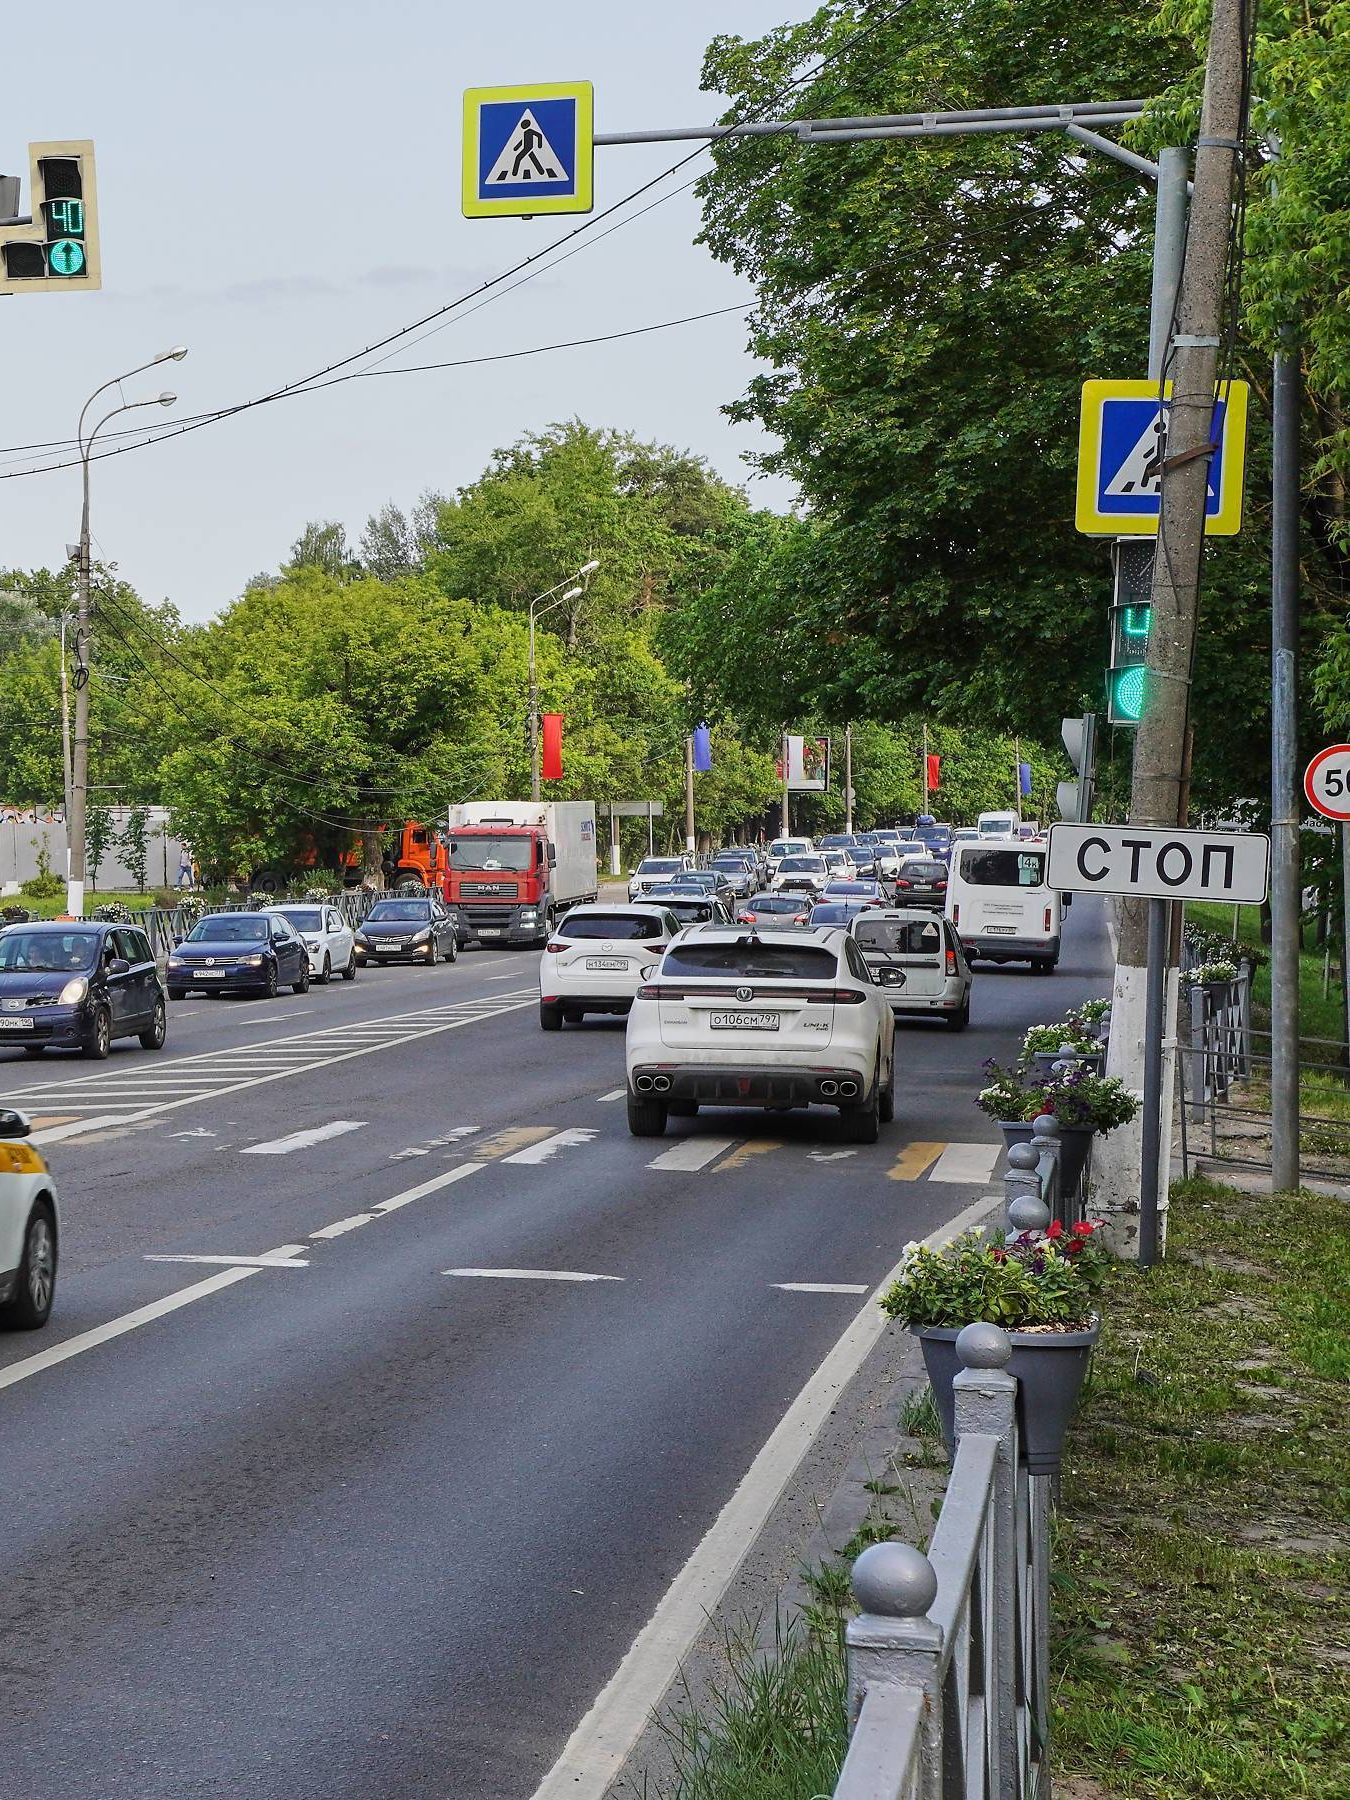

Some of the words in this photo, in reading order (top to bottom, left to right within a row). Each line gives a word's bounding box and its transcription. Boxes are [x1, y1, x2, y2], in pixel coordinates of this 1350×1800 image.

[51, 201, 83, 233] 40
[1324, 768, 1350, 797] 5
[1076, 836, 1235, 889] СТОП
